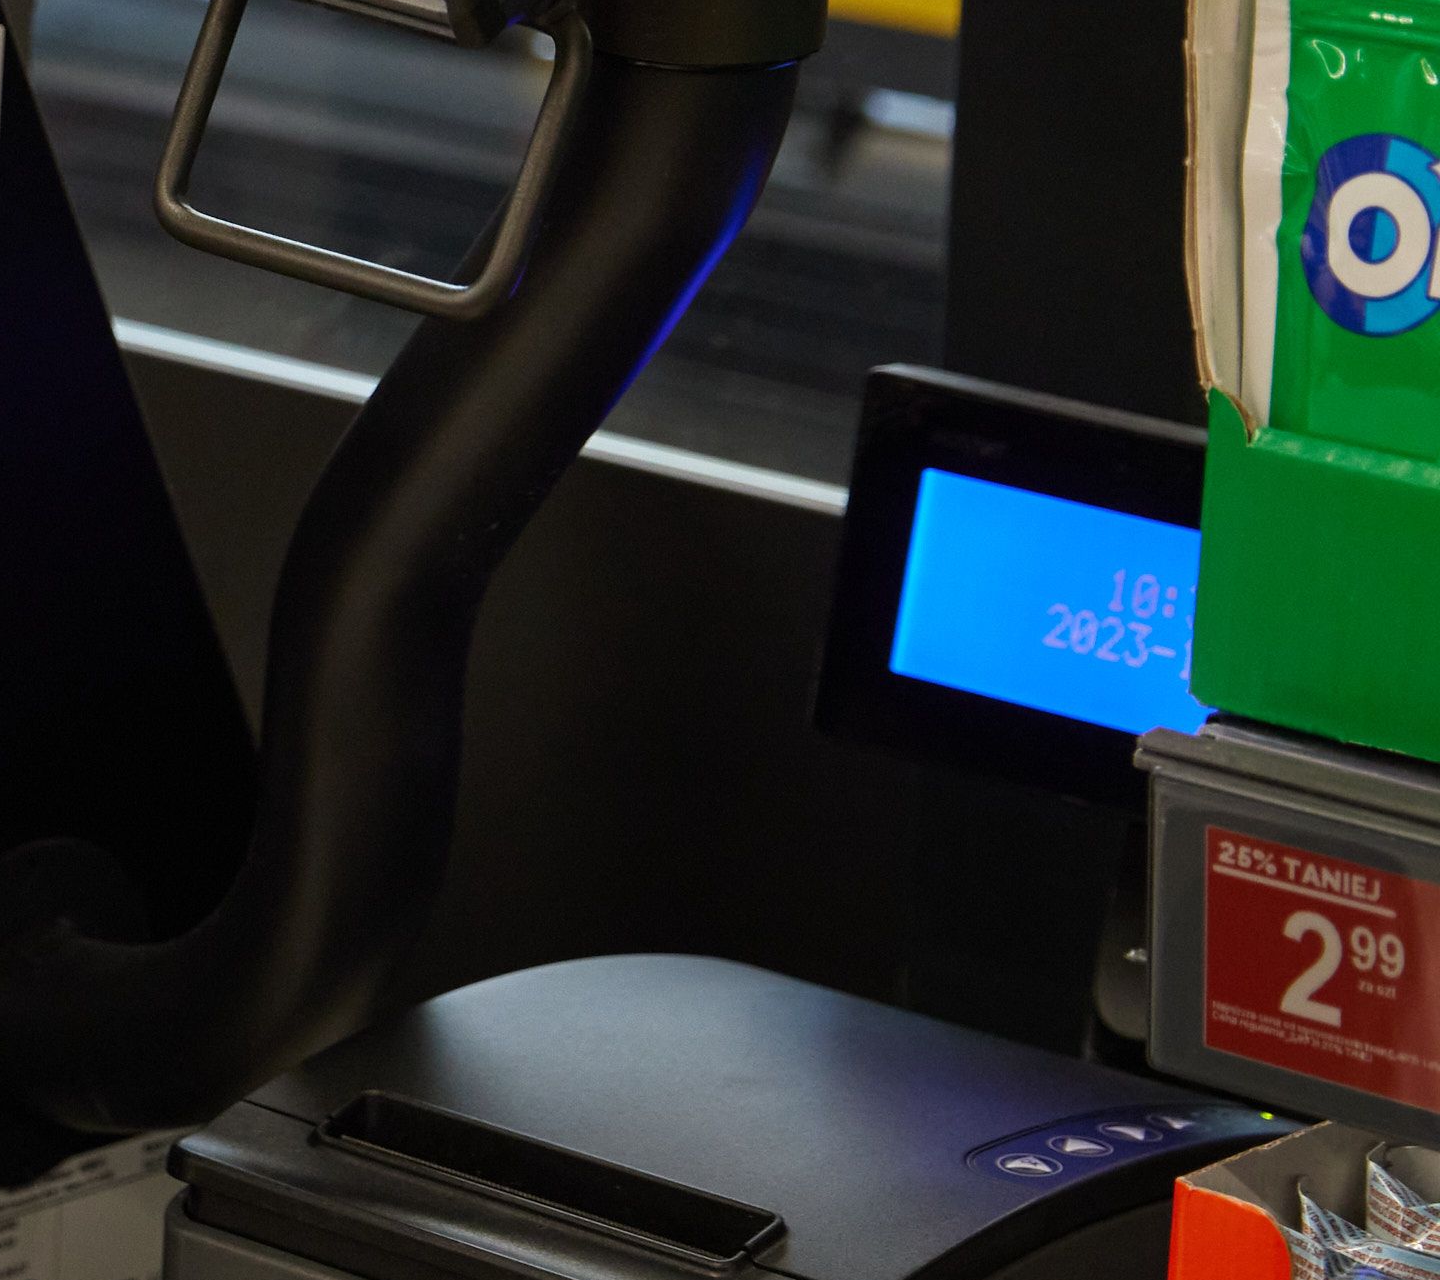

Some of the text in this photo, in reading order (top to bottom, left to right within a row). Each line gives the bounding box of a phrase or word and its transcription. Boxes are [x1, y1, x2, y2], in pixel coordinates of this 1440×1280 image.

[1108, 567, 1196, 620] 10:
[1282, 855, 1382, 902] TANIEJ
[1279, 909, 1406, 1028] 2 99
